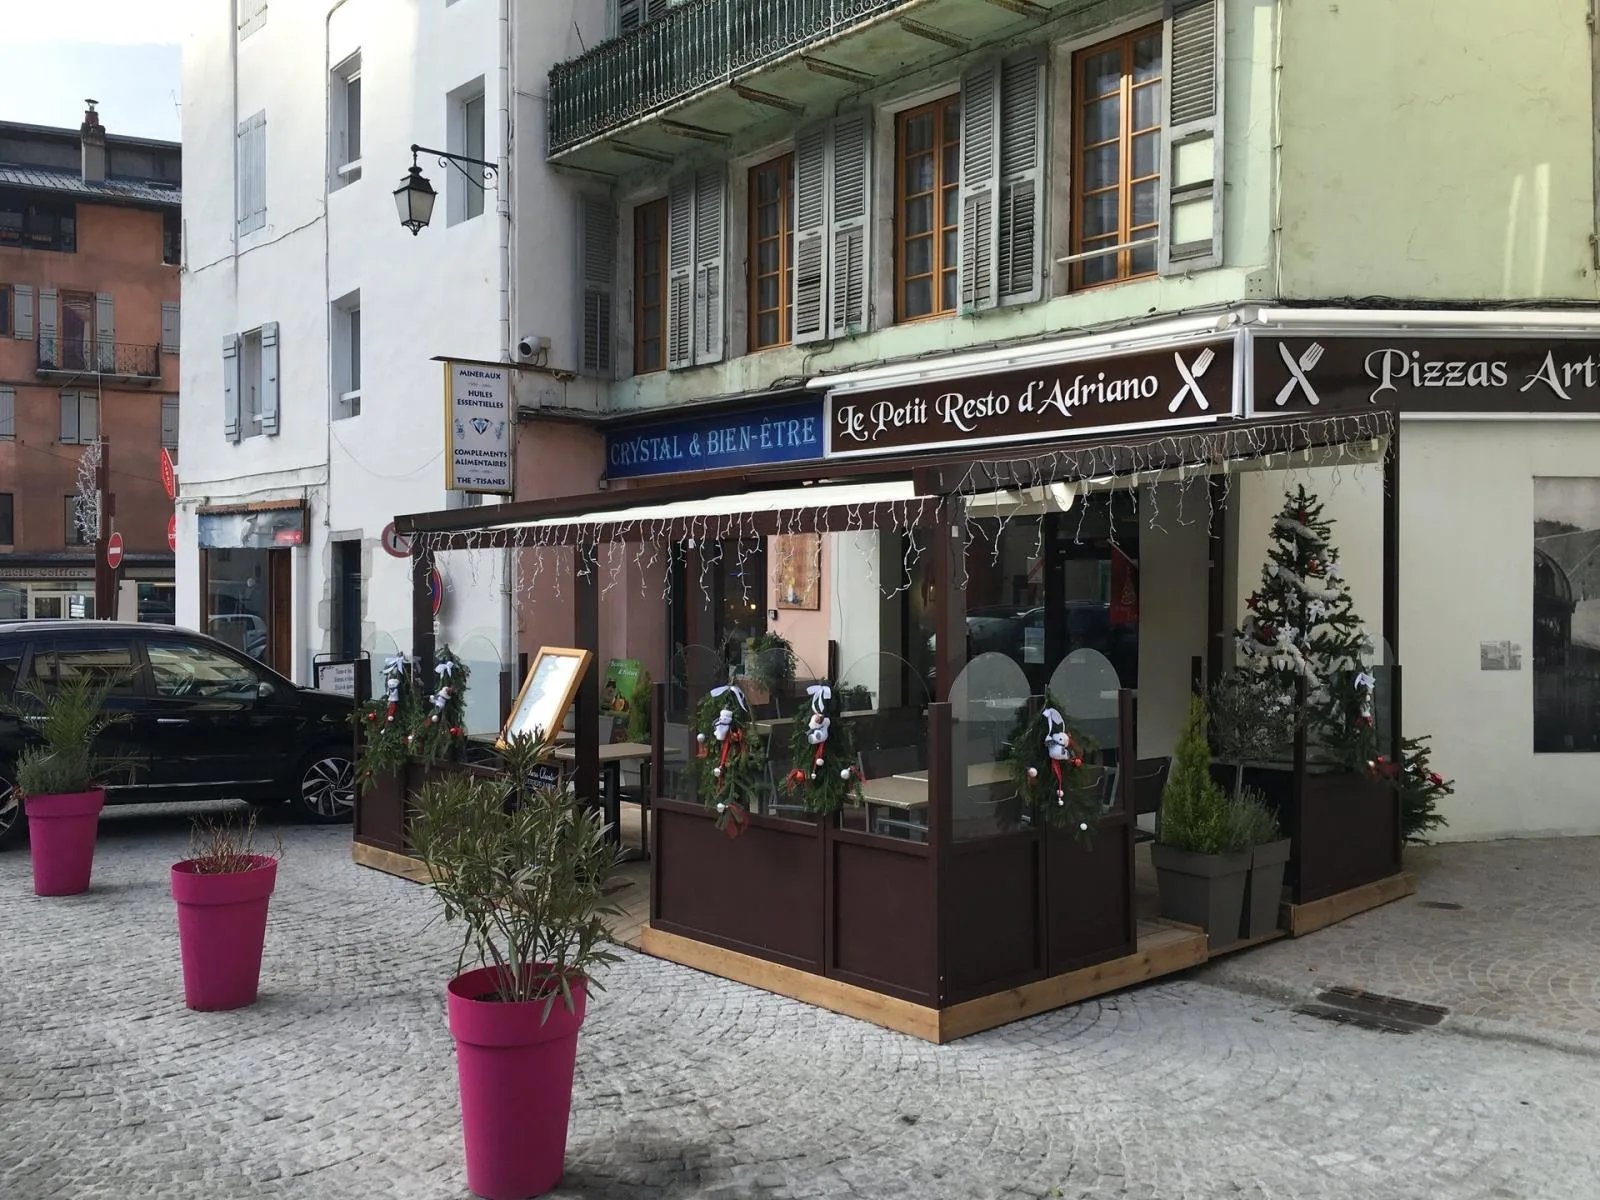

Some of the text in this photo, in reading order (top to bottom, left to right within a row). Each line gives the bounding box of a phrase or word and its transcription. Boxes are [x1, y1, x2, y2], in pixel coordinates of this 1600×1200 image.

[459, 370, 501, 380] MINERAUX
[1364, 348, 1508, 404] Pizzas
[468, 390, 493, 399] HUILES
[457, 398, 504, 409] ESSENTIELLES
[837, 371, 1158, 441] Le Petit Resto d'Adriano
[610, 416, 817, 466] CRYSTAL & BIEN-ÊTRE
[454, 448, 508, 459] COMPLEMENTS
[455, 458, 507, 468] ALIMENTAIRES
[456, 476, 472, 485] THE
